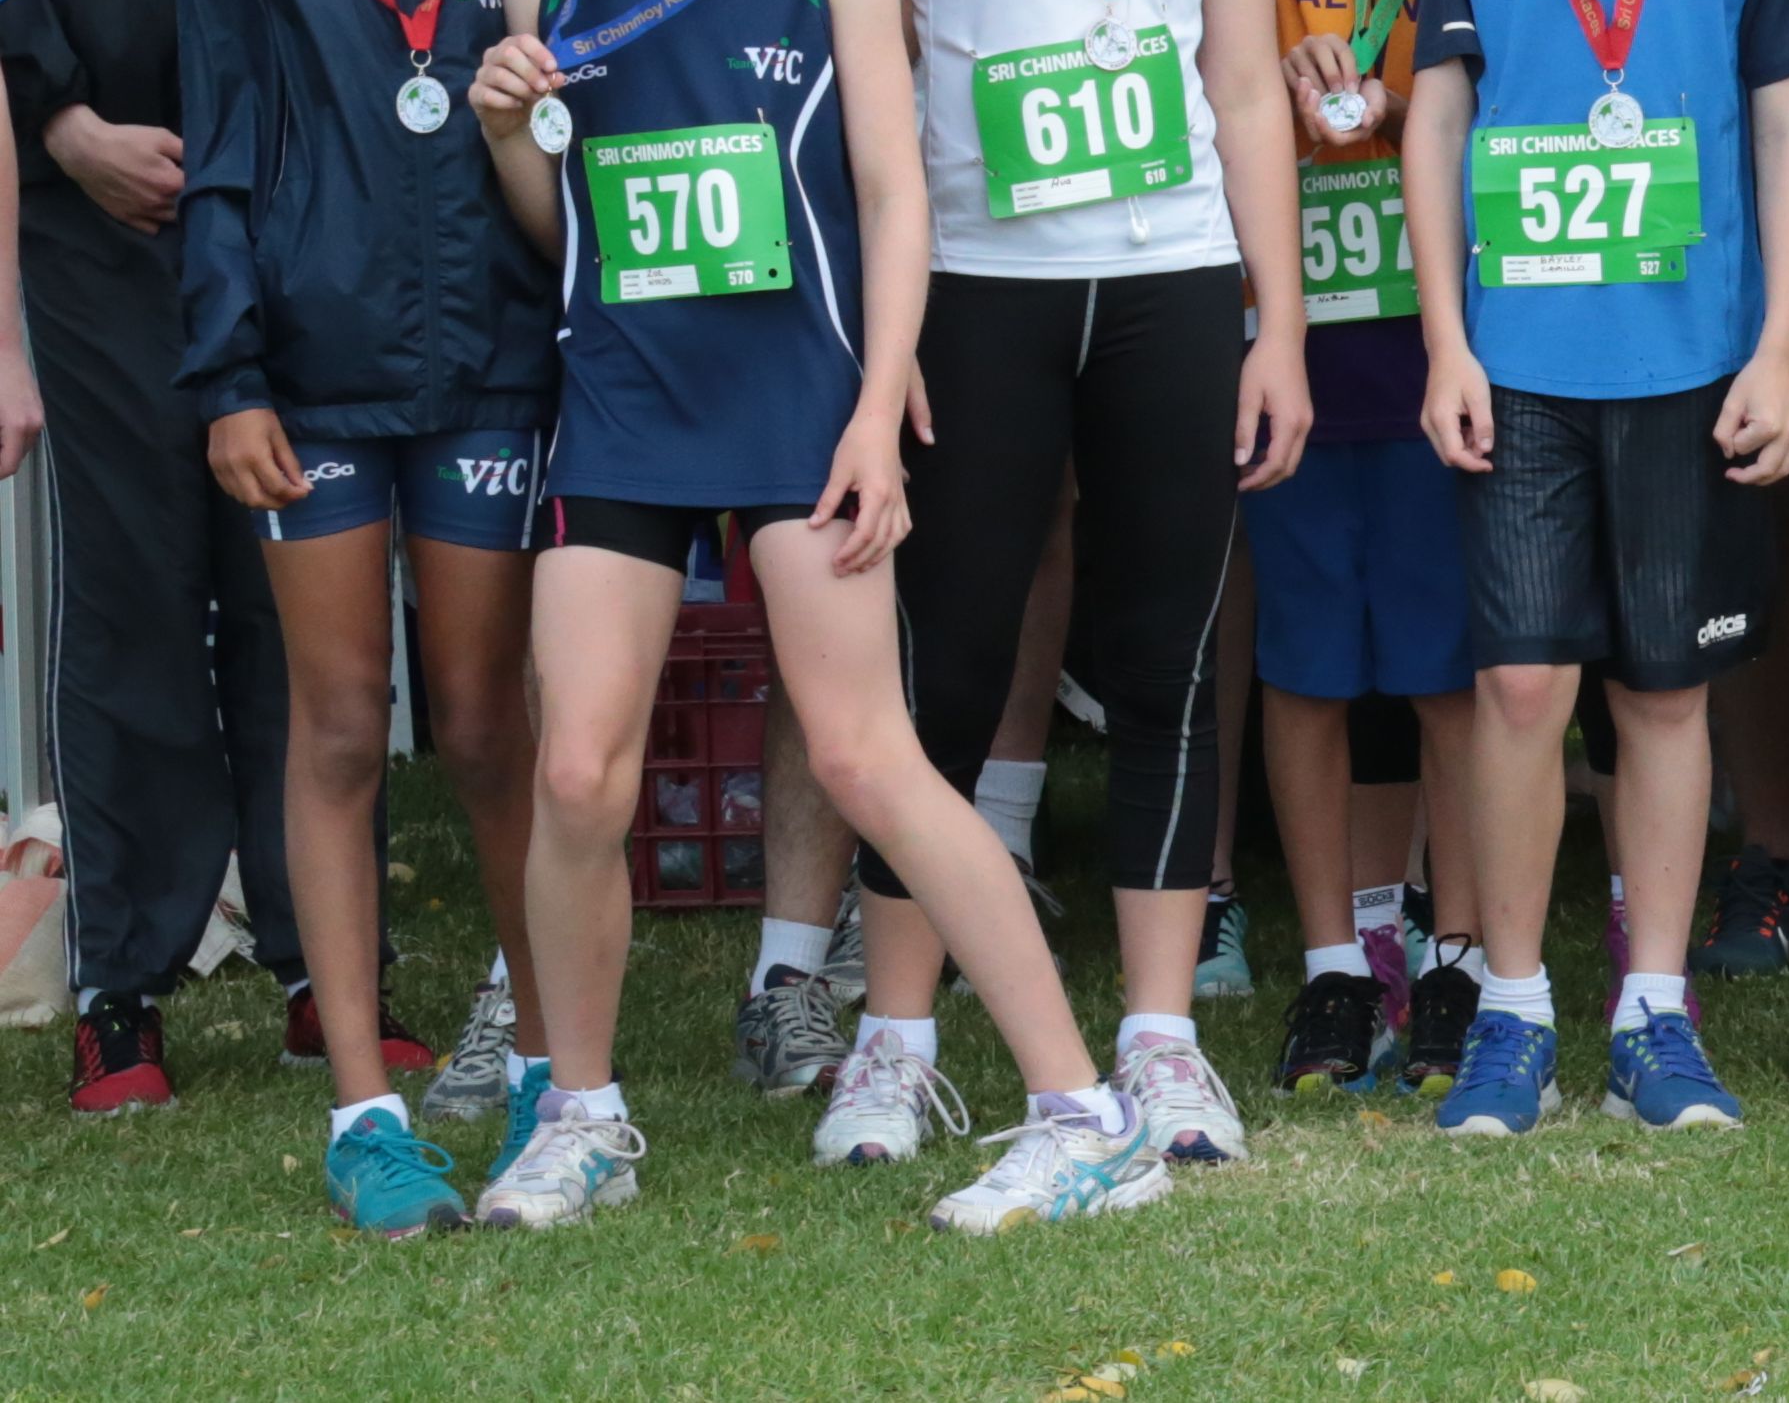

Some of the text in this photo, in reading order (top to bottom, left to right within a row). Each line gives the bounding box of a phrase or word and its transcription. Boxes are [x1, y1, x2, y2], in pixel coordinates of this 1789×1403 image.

[572, 35, 596, 56] Sri
[597, 1, 664, 47] Chinmoy
[1616, 11, 1632, 31] Sri
[987, 35, 1170, 84] SRI CHINM CES
[1021, 72, 1155, 166] 610
[595, 134, 764, 167] SRI CHINMOY RACES
[1488, 128, 1682, 156] SRI CHINMO ACES
[1144, 167, 1167, 186] 610
[1302, 169, 1382, 194] CHINMOY
[624, 168, 741, 256] 570
[1519, 161, 1653, 243] 527
[1302, 198, 1415, 282] 597
[728, 269, 755, 286] 570
[1639, 260, 1661, 276] 527
